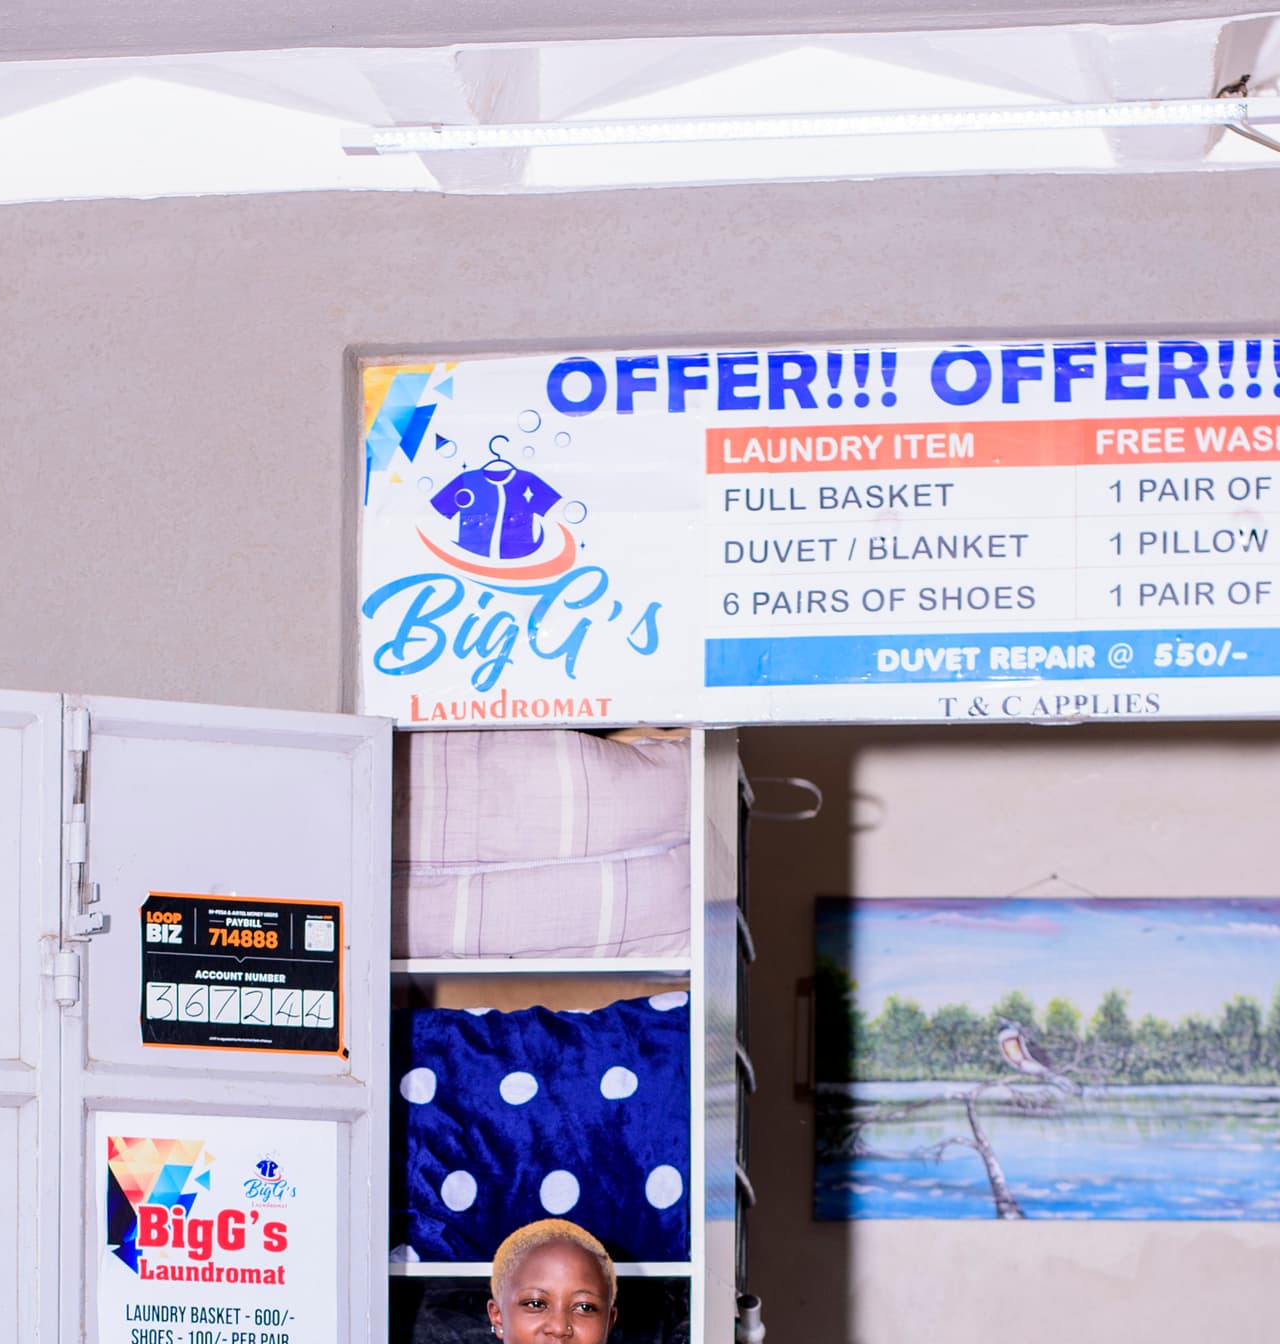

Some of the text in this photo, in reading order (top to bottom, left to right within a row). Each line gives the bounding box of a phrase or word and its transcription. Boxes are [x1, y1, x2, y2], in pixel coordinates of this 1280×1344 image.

[546, 348, 897, 417] OFFER!!!
[723, 431, 975, 464] LAUNDRY ITEM
[1096, 428, 1185, 455] FREE
[724, 483, 954, 512] FULL BASKET
[1109, 480, 1122, 502] 1
[1139, 477, 1215, 502] PAIR
[1228, 476, 1272, 501] OF
[724, 534, 1029, 563] DUVET / BLANKET
[1109, 528, 1268, 555] 1 PILLOW
[723, 585, 1036, 615] 6 PAIRS OF SHOES
[1109, 584, 1122, 607] 1
[1139, 582, 1215, 607] PAIR
[1228, 581, 1272, 605] OF
[877, 640, 1248, 672] DUVET REPAIR @ 550/-
[938, 693, 1161, 717] T & C APPLIES
[146, 911, 182, 924] LOOP
[226, 918, 262, 928] PAYBILL
[146, 924, 183, 944] BIZ
[209, 928, 279, 949] 714888
[195, 969, 287, 984] ACCOUNT NUMBER
[138, 1204, 288, 1262] BigG's
[140, 1259, 286, 1285] Laundromat
[126, 1304, 186, 1323] LAUNDRY
[191, 1307, 241, 1325] BASKET
[254, 1309, 295, 1326] 600/-
